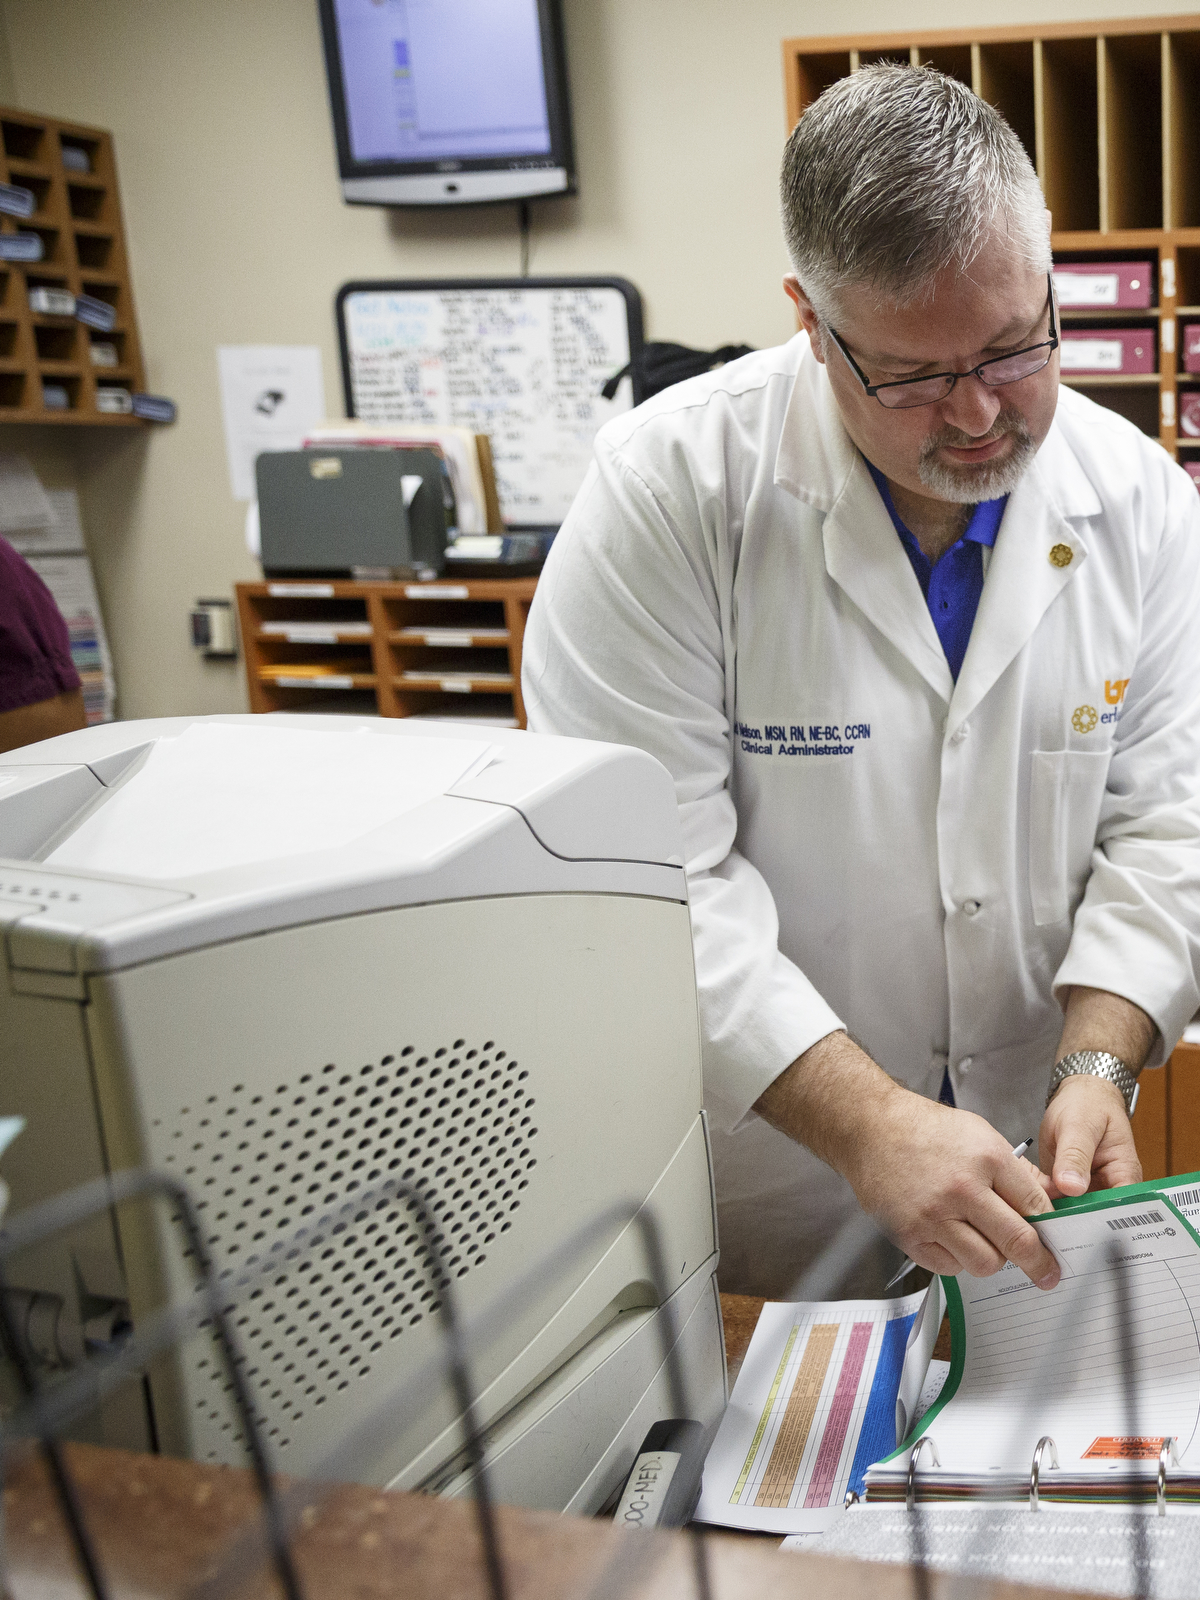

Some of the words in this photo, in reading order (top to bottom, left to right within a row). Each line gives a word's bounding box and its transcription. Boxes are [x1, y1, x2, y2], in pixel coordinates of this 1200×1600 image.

[764, 725, 788, 742] MSN,
[790, 726, 806, 742] RN,
[809, 726, 842, 742] NE-BC,
[844, 724, 870, 740] CCRN
[741, 740, 772, 755] Clinical
[778, 744, 854, 756] Administrator
[1130, 1228, 1165, 1242] erlanger
[1123, 1251, 1153, 1261] PROGRESS
[1006, 1553, 1074, 1564] WRITE
